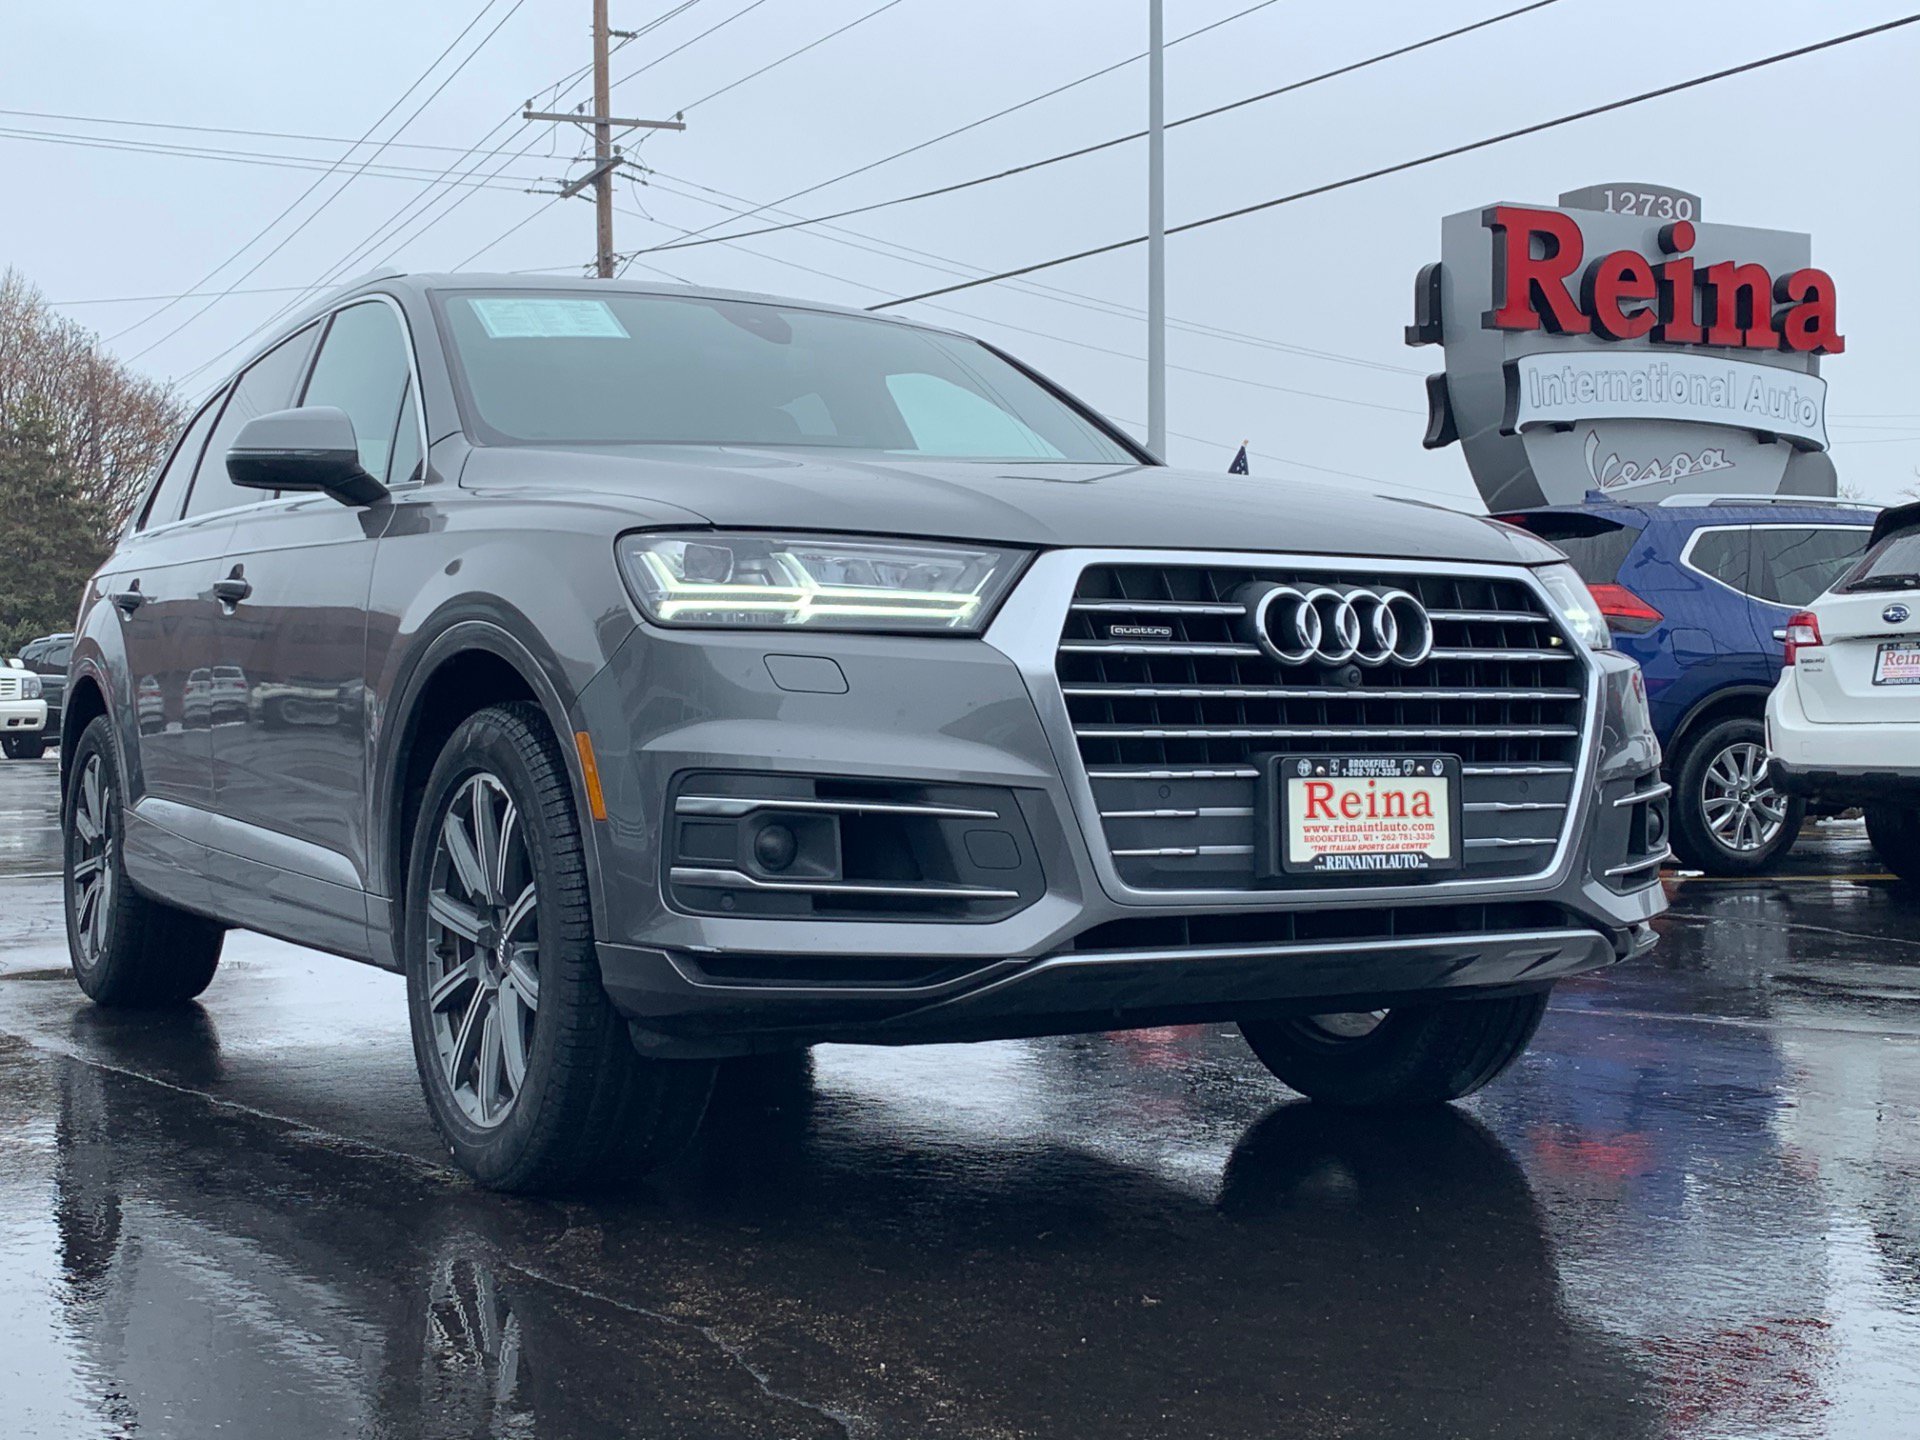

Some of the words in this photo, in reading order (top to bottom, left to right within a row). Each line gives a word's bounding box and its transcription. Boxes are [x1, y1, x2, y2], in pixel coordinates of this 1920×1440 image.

[1604, 190, 1693, 221] 12730
[1484, 206, 1845, 355] Reina
[1529, 363, 1736, 410] International
[1744, 374, 1818, 429] Auto
[1584, 429, 1735, 492] Vespa
[1114, 627, 1170, 635] quattro
[1348, 759, 1396, 768] BROOKFIELD
[1303, 779, 1434, 820] Reina
[1303, 821, 1435, 833] www.reinaintlauto.com
[1304, 834, 1361, 843] BROOKFIELD,
[1358, 843, 1384, 851] SPORTS
